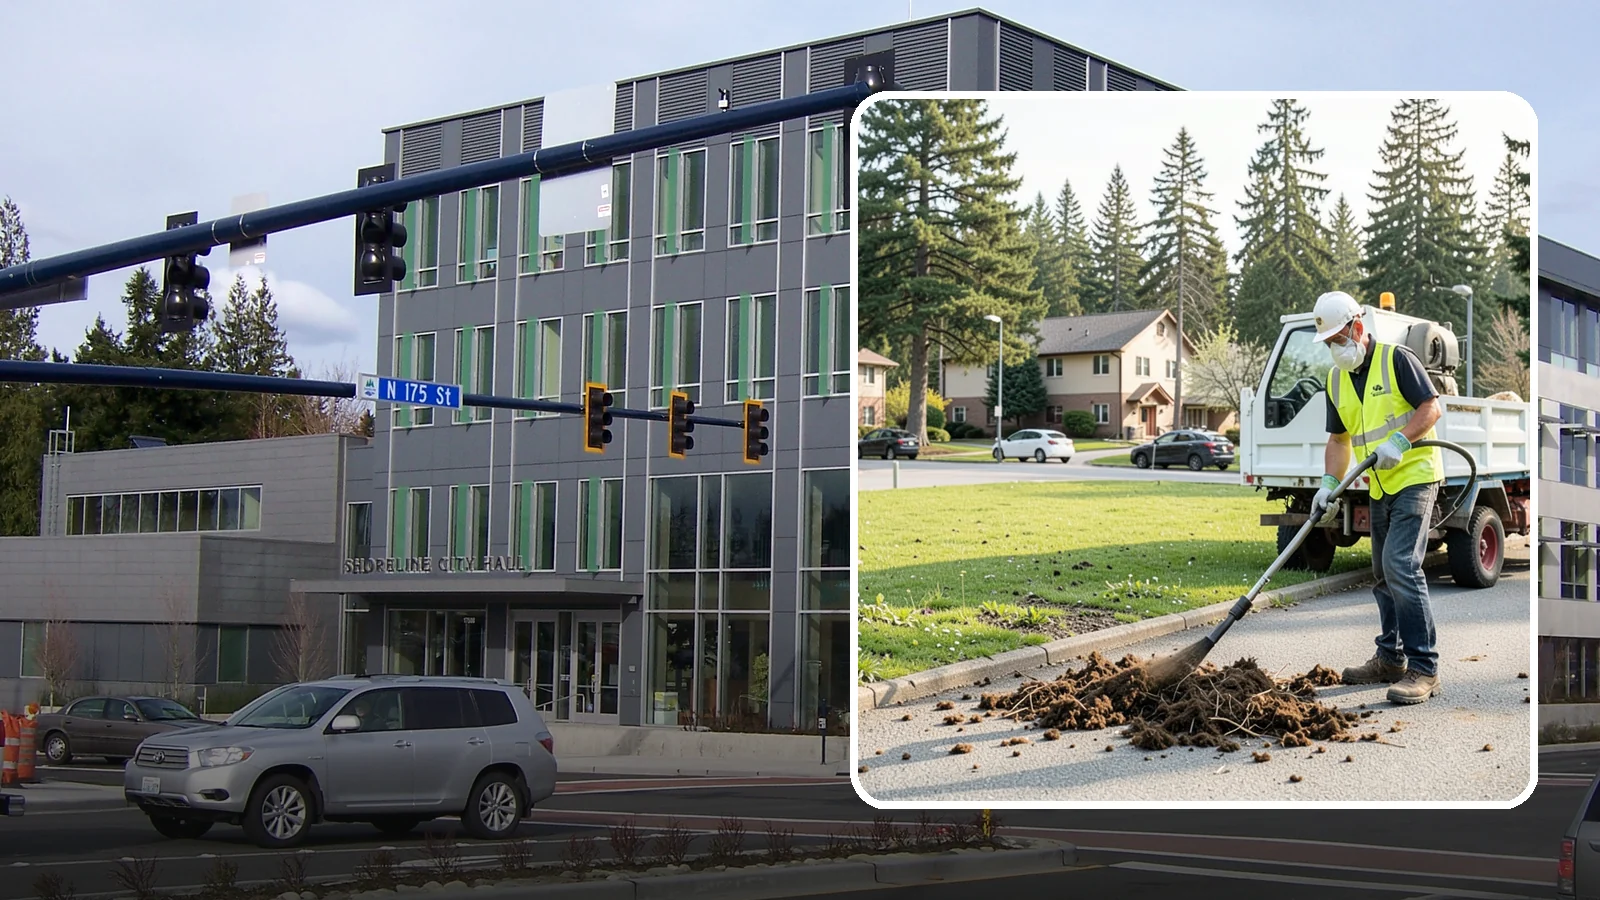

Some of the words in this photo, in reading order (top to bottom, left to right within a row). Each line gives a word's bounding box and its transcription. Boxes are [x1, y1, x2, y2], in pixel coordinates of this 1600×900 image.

[387, 380, 396, 400] N
[405, 382, 428, 403] 175
[436, 386, 452, 406] St
[345, 556, 432, 574] SHORELINE
[438, 556, 477, 573] CITY
[484, 555, 526, 573] HALL
